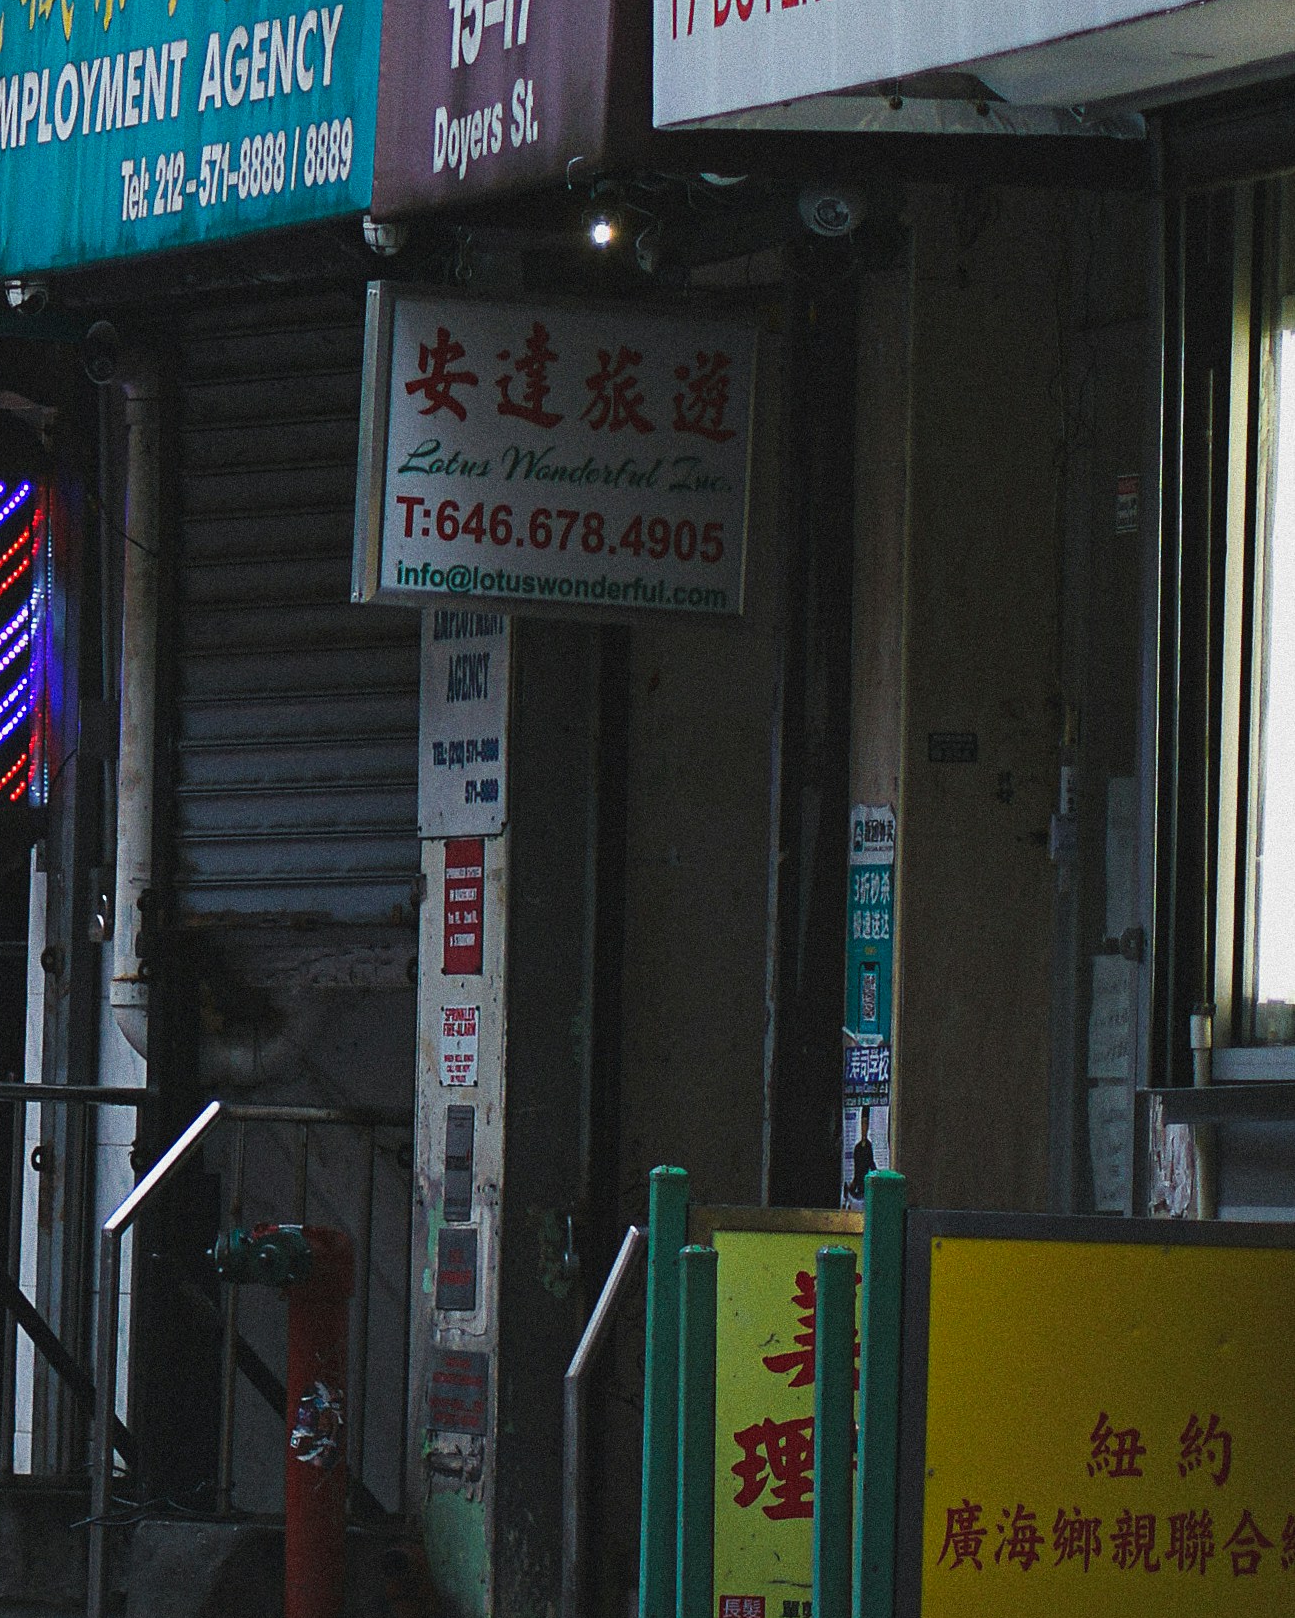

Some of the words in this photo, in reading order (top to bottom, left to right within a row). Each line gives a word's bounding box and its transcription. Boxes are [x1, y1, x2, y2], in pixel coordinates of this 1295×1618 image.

[198, 4, 345, 110] AGENCY
[303, 117, 354, 184] 8889
[433, 100, 503, 181] Doyers
[510, 77, 541, 148] St.
[398, 438, 493, 480] Lotus
[501, 445, 659, 492] Wonderful
[396, 495, 726, 564] T:646.678.4905
[396, 560, 727, 610] info@lotuswonderful.com
[1086, 1411, 1232, 1486] 紐約
